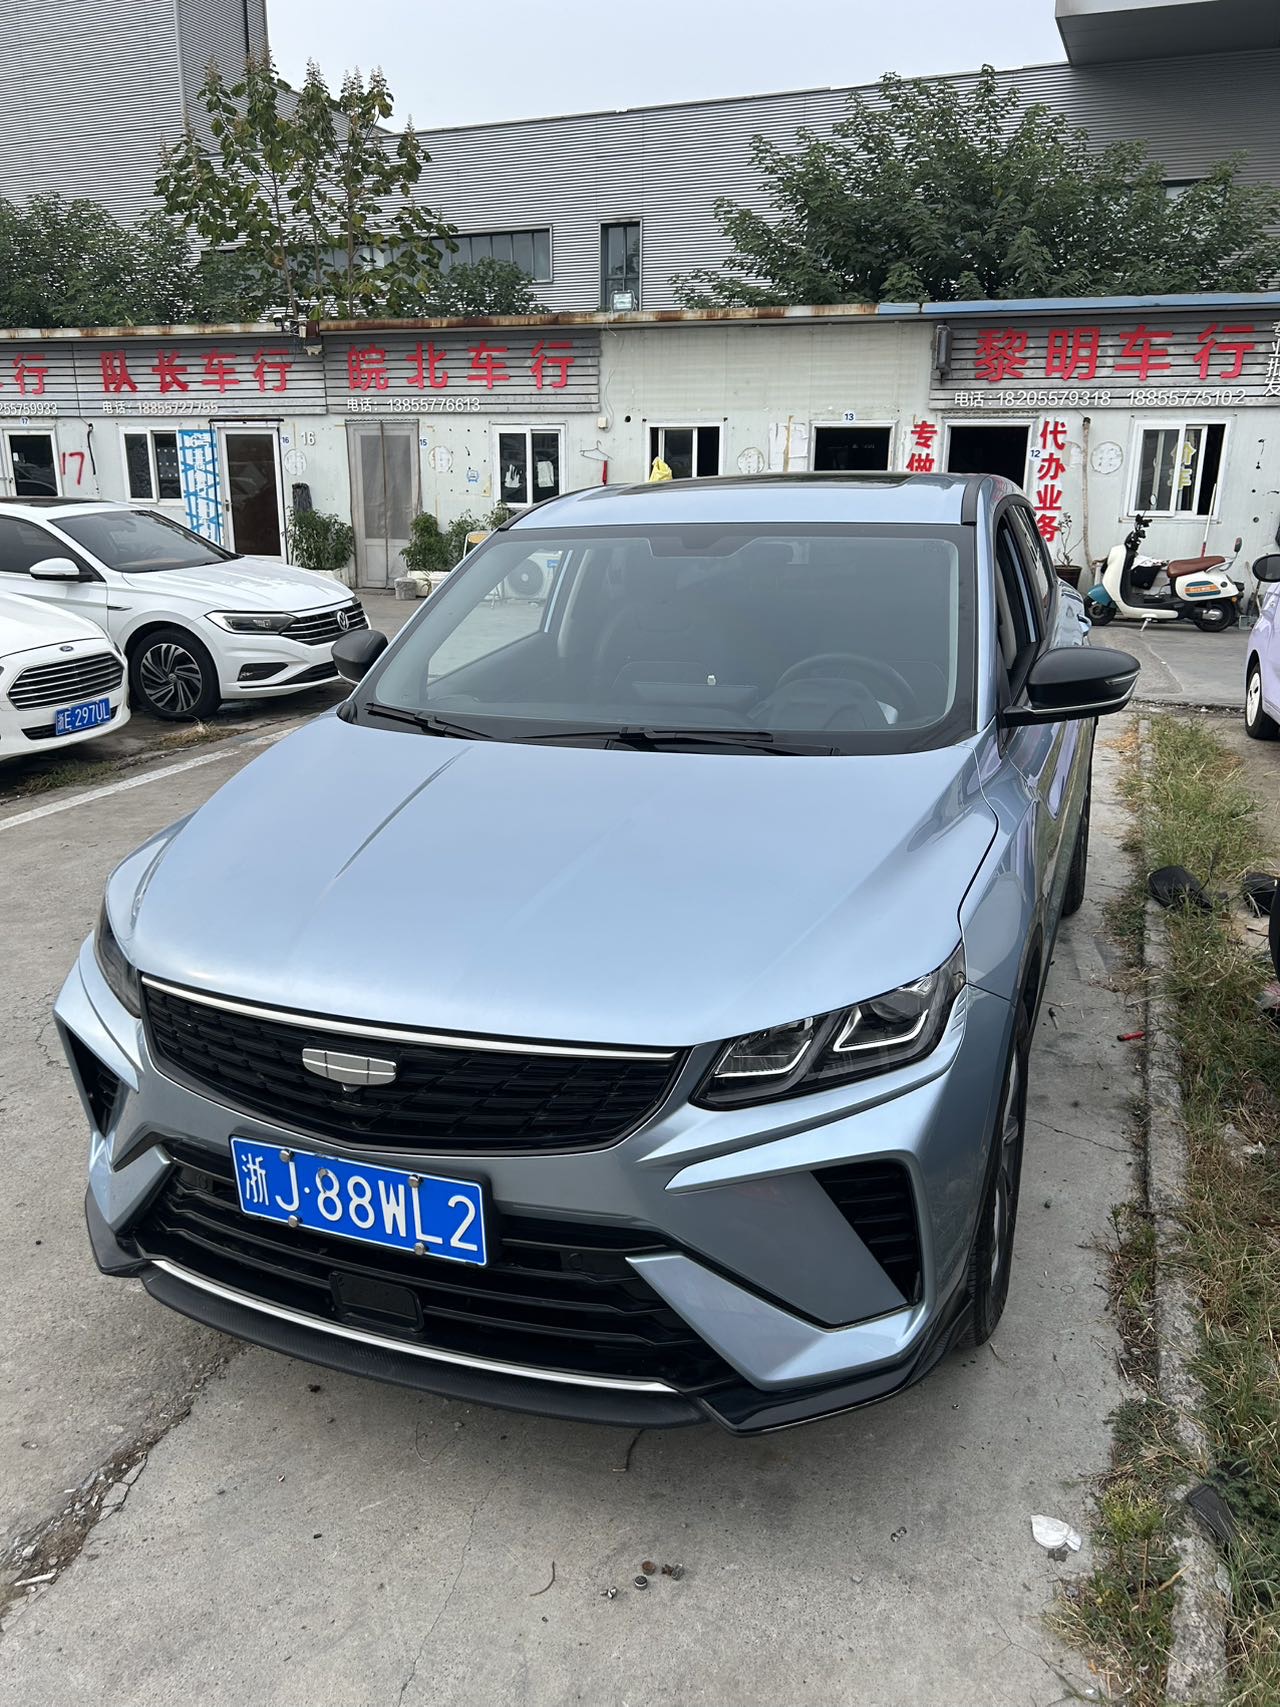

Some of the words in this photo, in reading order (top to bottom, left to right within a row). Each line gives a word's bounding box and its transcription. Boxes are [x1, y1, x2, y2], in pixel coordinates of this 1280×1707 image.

[100, 348, 293, 393] 队长车行
[347, 339, 575, 390] 皖北车行
[974, 323, 1255, 381] 黎明车行
[0, 352, 48, 395] 行
[1127, 389, 1245, 406] 18855775102
[844, 413, 854, 421] 13
[300, 431, 316, 446] 16
[1030, 450, 1041, 458] 12
[62, 452, 85, 485] 17
[1034, 421, 1067, 542] 代办业务
